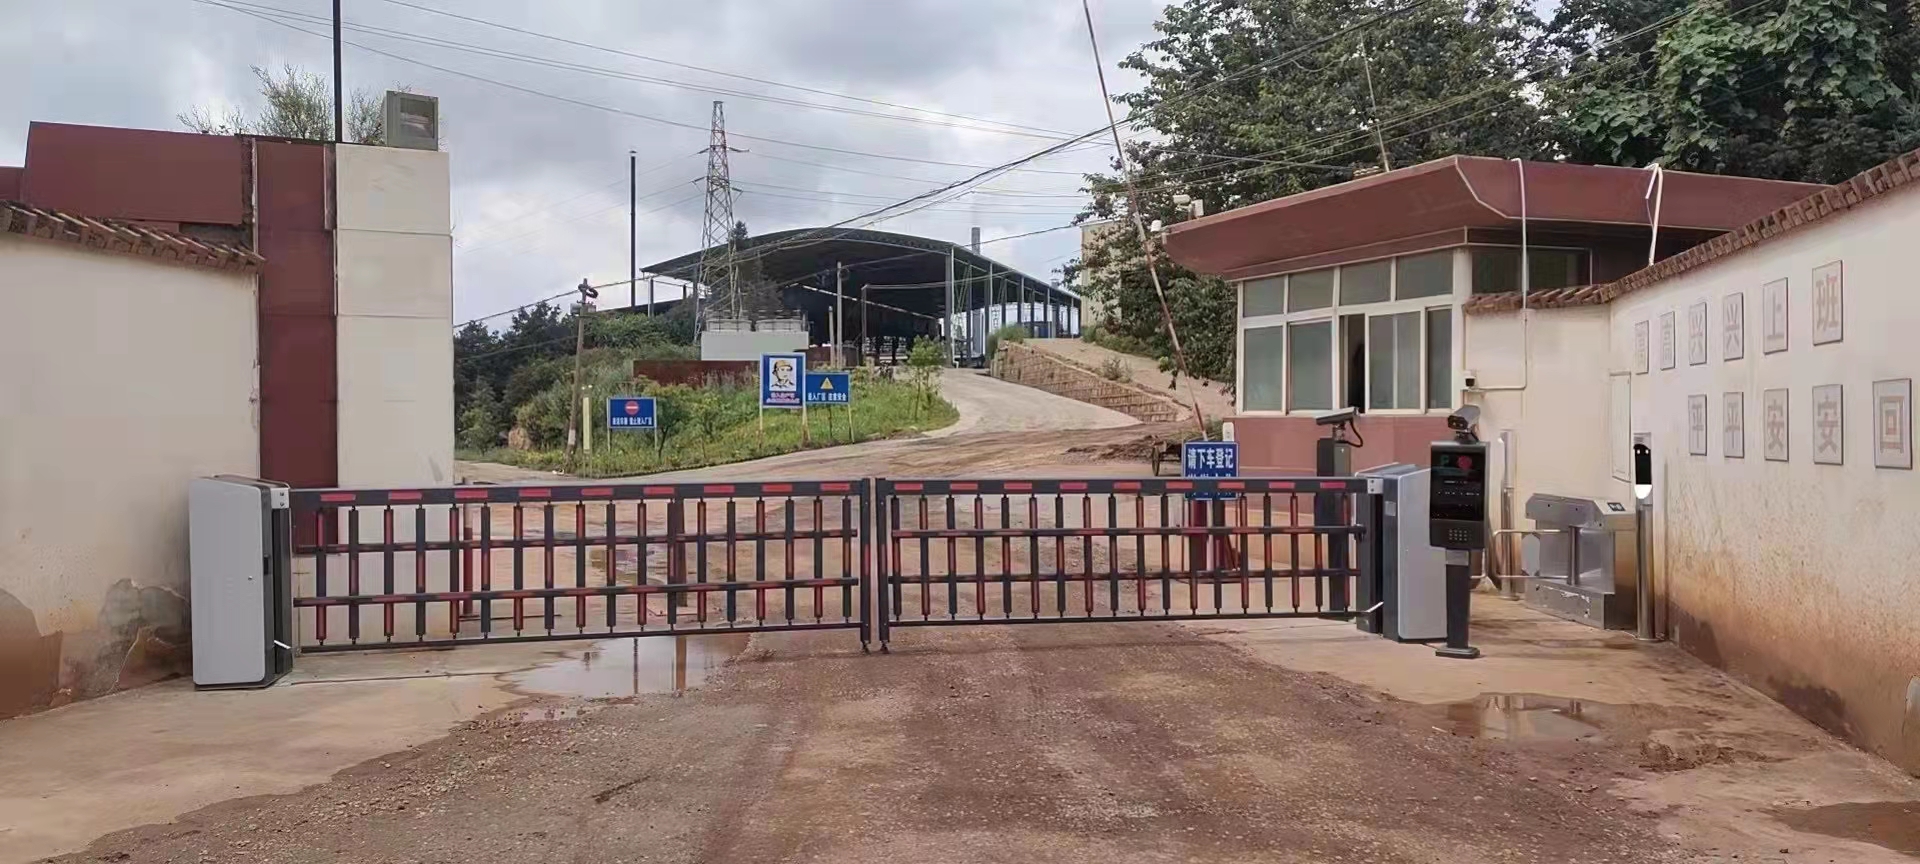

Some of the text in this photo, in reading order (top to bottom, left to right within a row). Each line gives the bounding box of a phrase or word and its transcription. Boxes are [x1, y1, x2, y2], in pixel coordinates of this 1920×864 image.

[1187, 447, 1234, 469] 请下车登记
